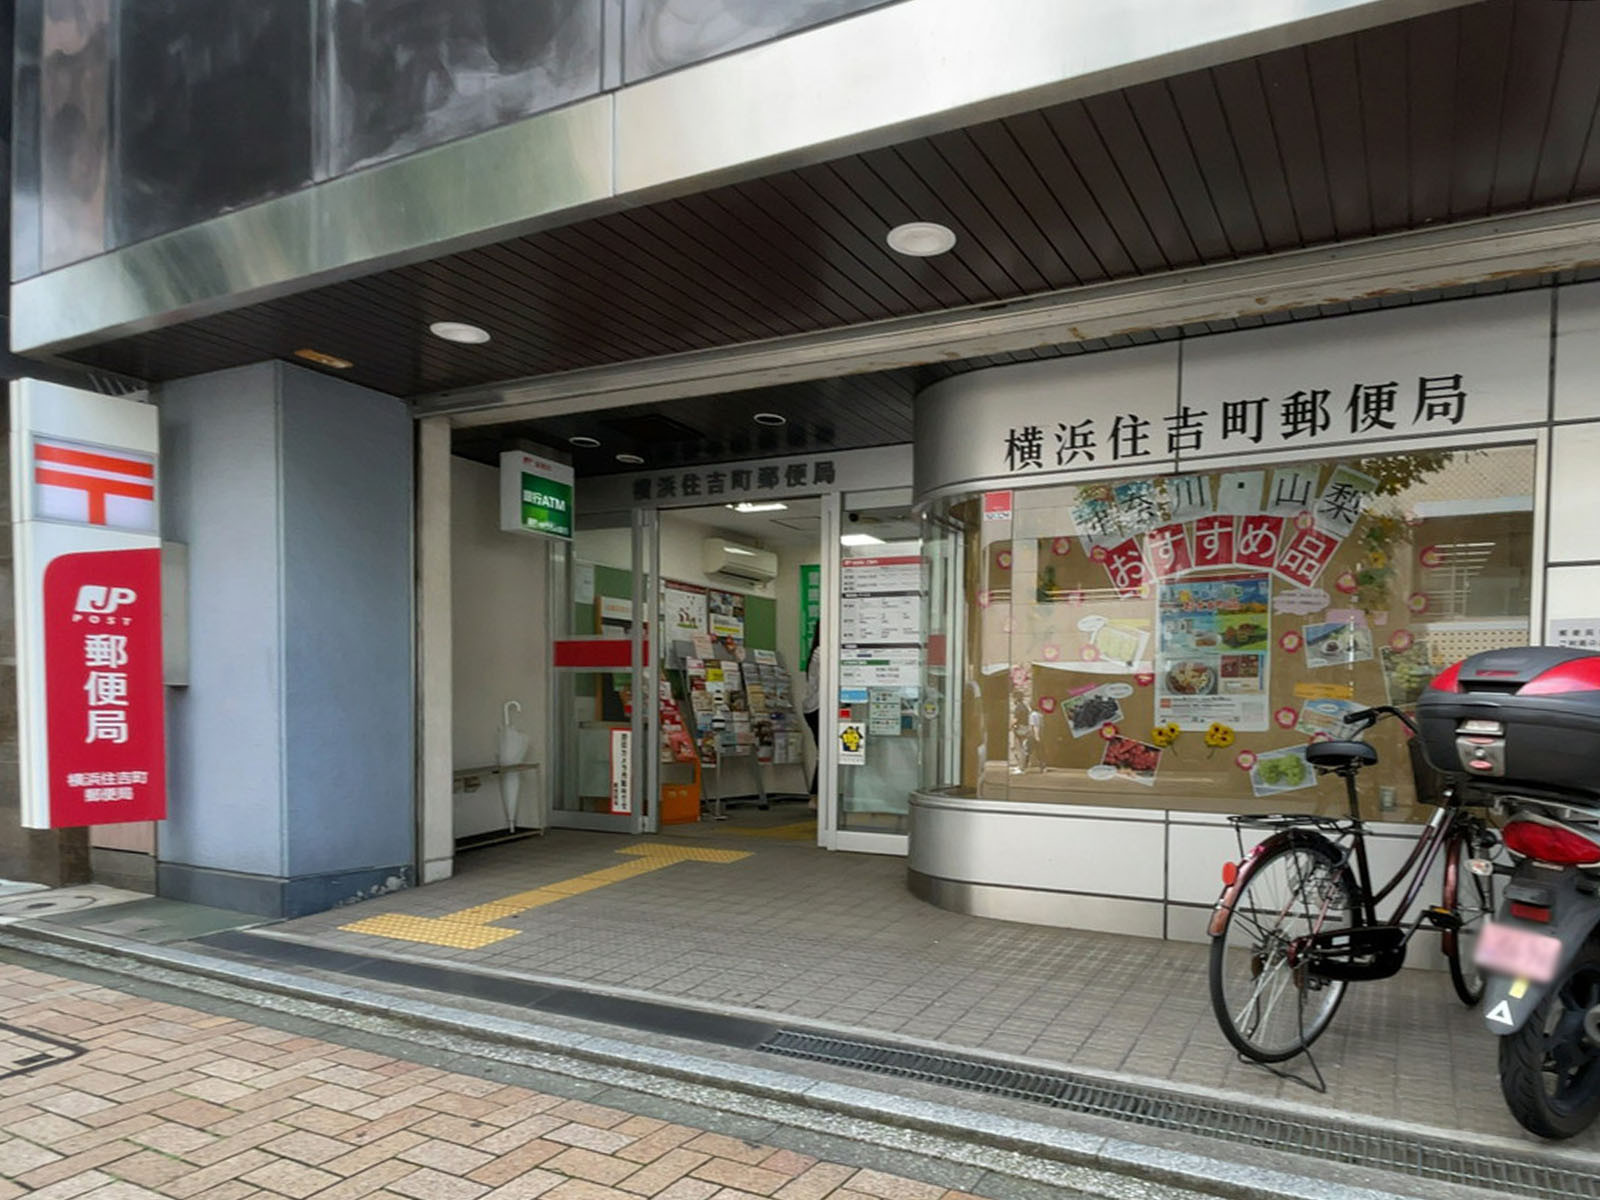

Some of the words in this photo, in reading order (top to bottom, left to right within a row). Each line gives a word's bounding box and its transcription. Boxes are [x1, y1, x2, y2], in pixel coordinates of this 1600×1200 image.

[1002, 373, 1468, 472] 横浜住吉町郵便局
[633, 460, 836, 500] 横浜住吉町郵便局
[1110, 521, 1325, 588] おすすめ品
[72, 613, 133, 626] POST
[84, 633, 128, 744] 郵便局
[66, 770, 149, 788] 横浜住吉町
[84, 786, 134, 802] 郵便局
